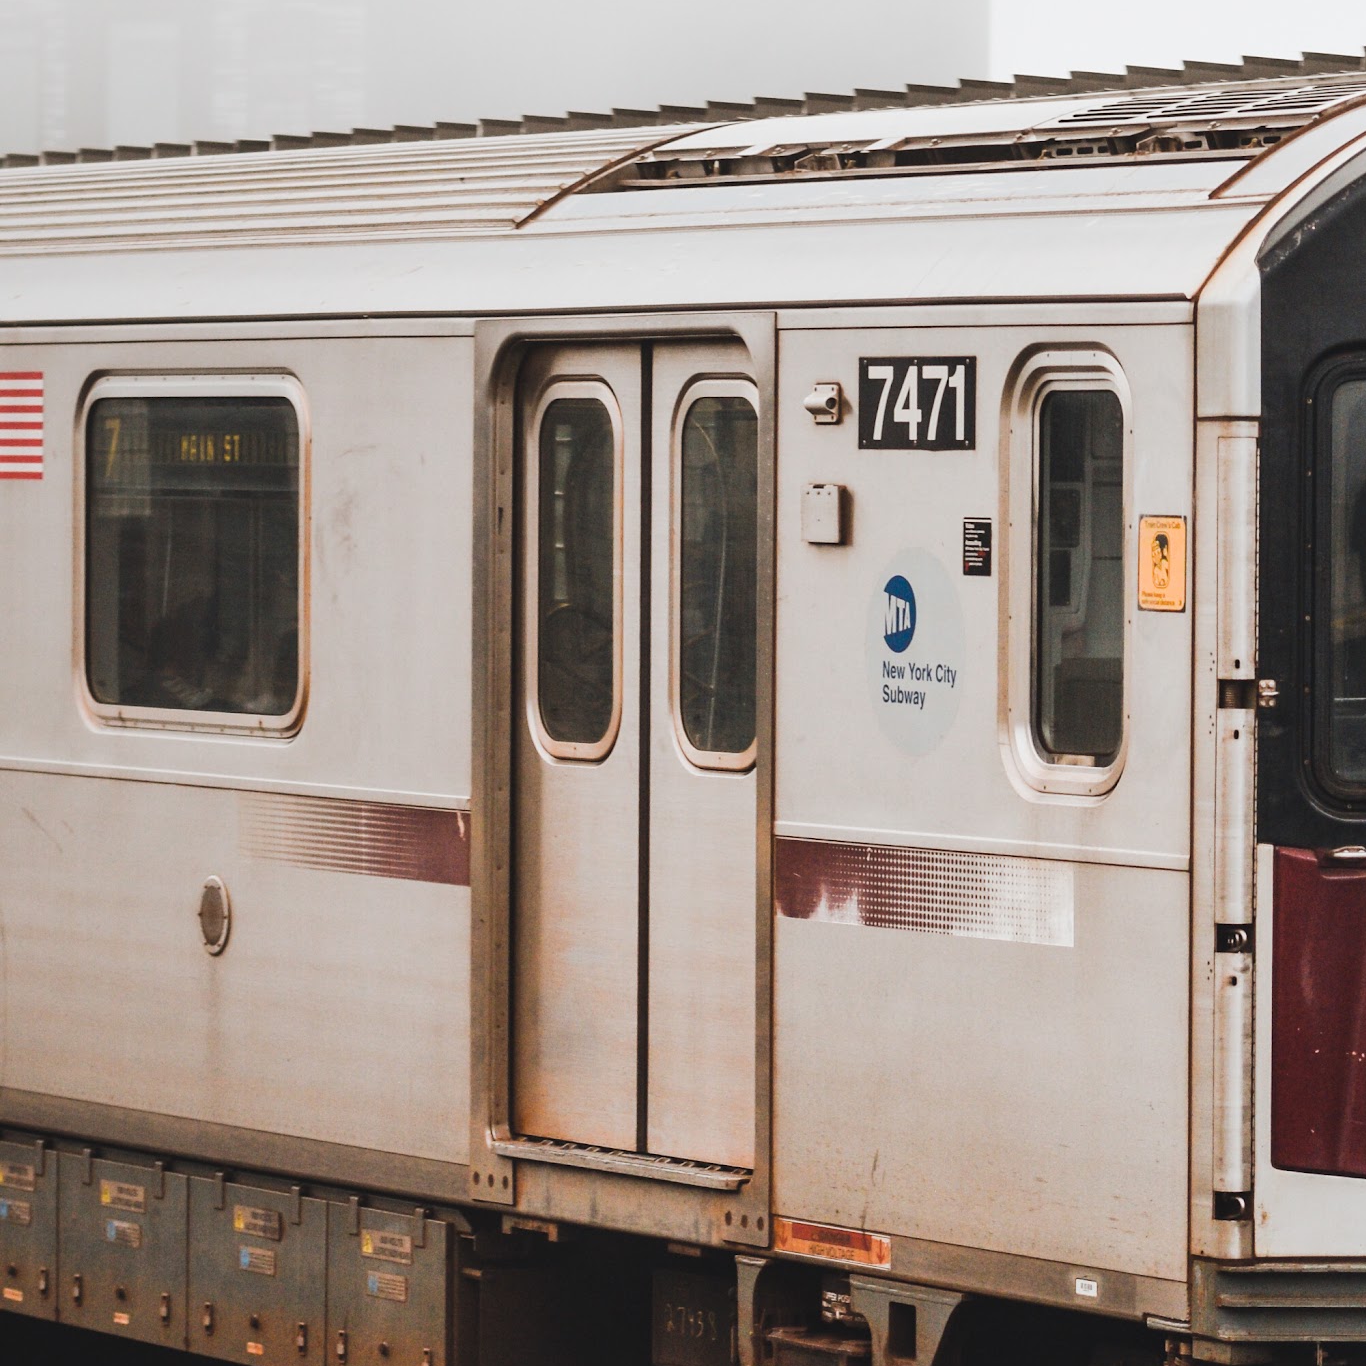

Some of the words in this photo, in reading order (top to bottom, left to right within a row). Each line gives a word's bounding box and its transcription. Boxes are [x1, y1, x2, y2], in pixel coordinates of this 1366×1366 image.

[868, 365, 965, 440] 7471
[105, 418, 121, 477] 7
[224, 435, 240, 462] ST
[884, 590, 911, 636] MTA
[882, 661, 905, 679] New
[909, 662, 932, 682] York
[936, 664, 957, 688] City
[882, 684, 926, 710] Subway
